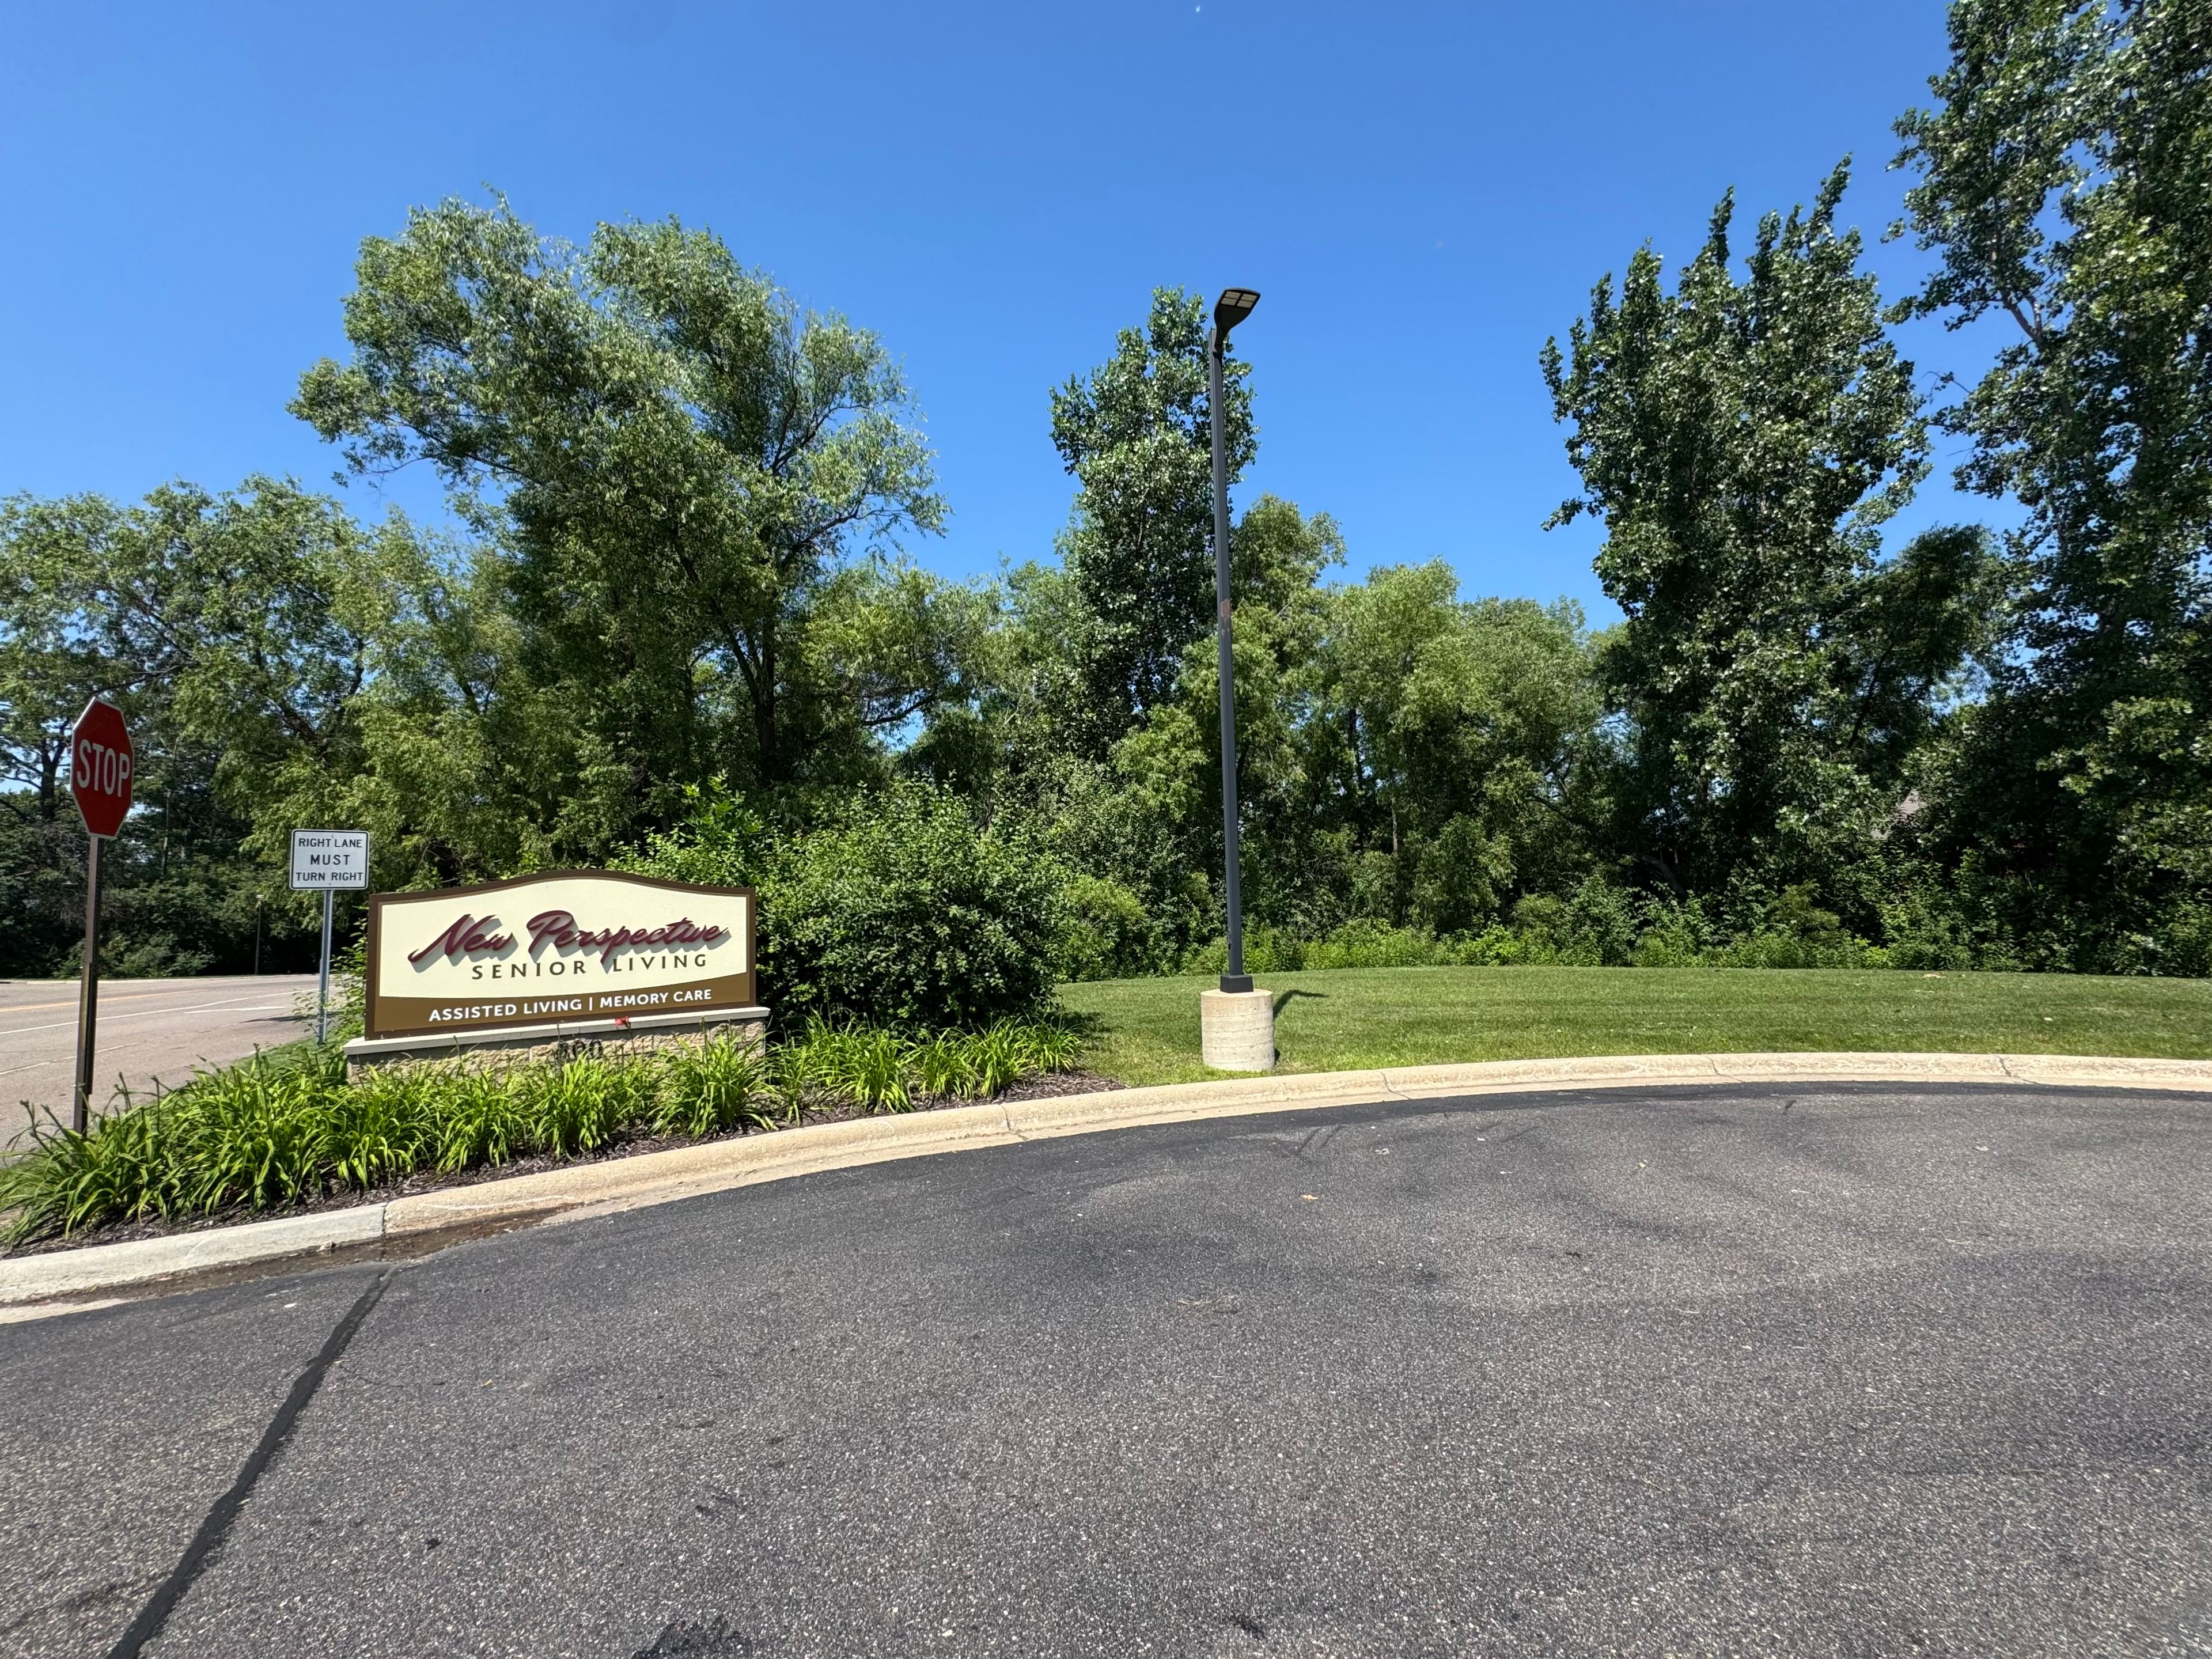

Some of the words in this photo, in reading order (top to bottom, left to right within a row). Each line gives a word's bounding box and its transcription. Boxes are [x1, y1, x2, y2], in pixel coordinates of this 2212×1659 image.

[77, 739, 130, 797] STOP
[298, 838, 332, 847] RIGHT
[334, 839, 363, 848] LANE
[310, 854, 350, 865] MUST
[296, 872, 325, 881] TURN
[331, 872, 363, 881] RIGHT
[407, 914, 514, 963] New
[526, 910, 728, 964] Perspective
[472, 960, 586, 980] SENIOR
[612, 954, 706, 972] LIVING
[429, 1003, 517, 1022] ASSISTED
[523, 999, 582, 1014] LIVING
[600, 992, 669, 1008] MEMORY
[673, 989, 712, 1002] CARE
